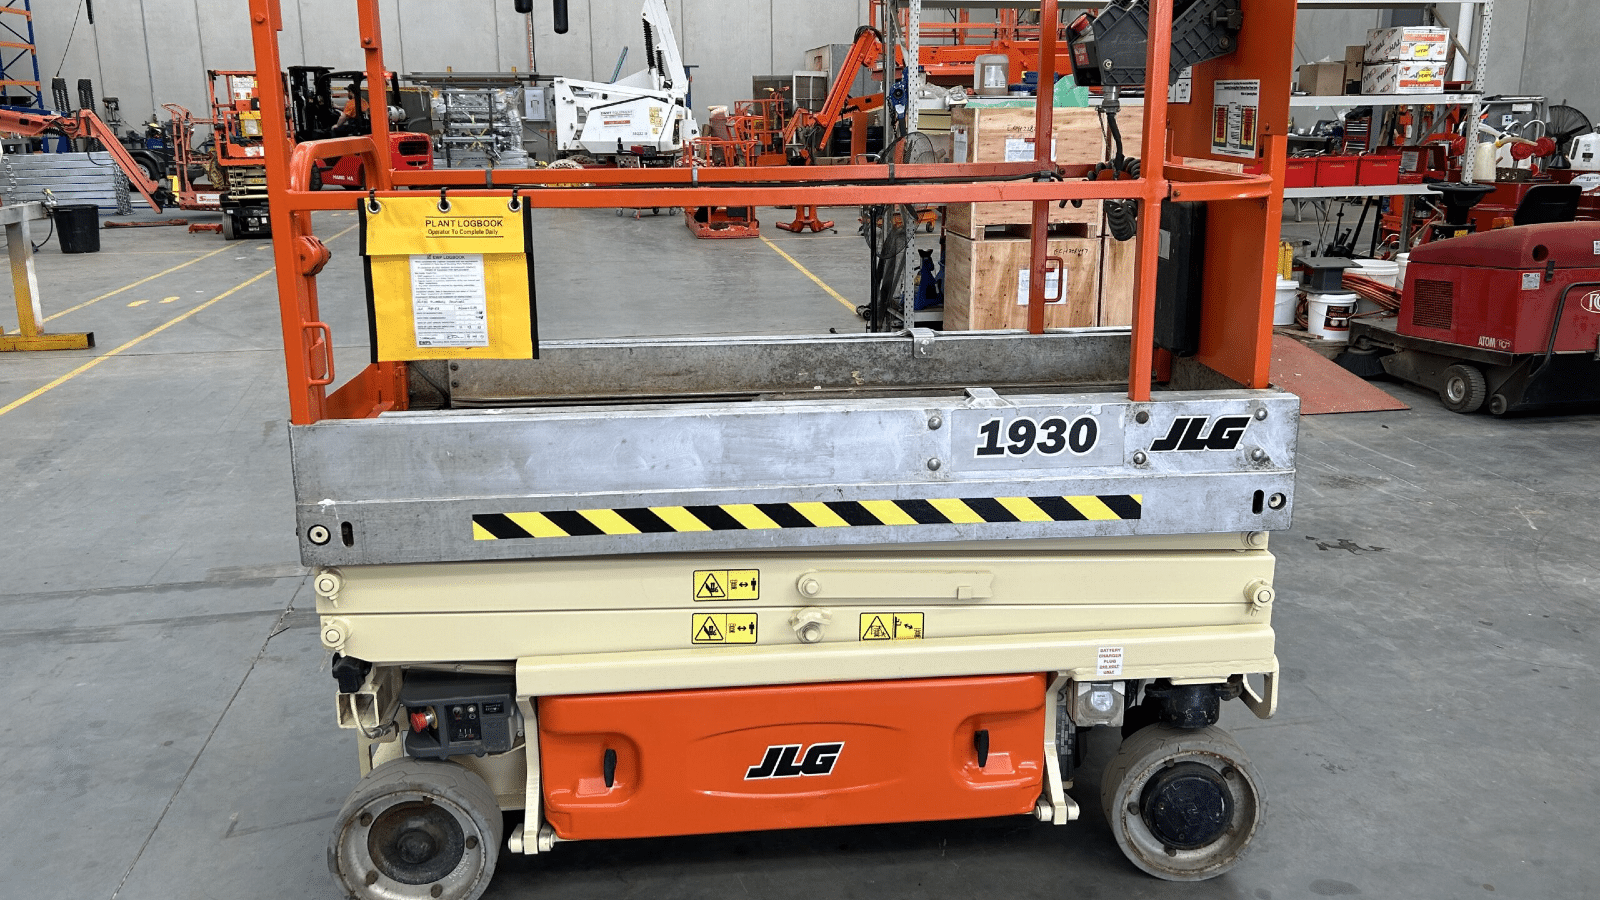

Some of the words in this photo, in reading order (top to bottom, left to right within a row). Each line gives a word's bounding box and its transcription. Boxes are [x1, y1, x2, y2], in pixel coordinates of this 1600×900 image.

[425, 219, 456, 228] PLANT
[457, 219, 503, 228] LOGBOOK
[427, 228, 450, 236] Operator
[459, 228, 485, 236] Complete
[1478, 335, 1496, 348] ATOM
[975, 415, 1102, 458] 1930
[1149, 415, 1252, 452] JLG
[744, 741, 845, 780] JLG
